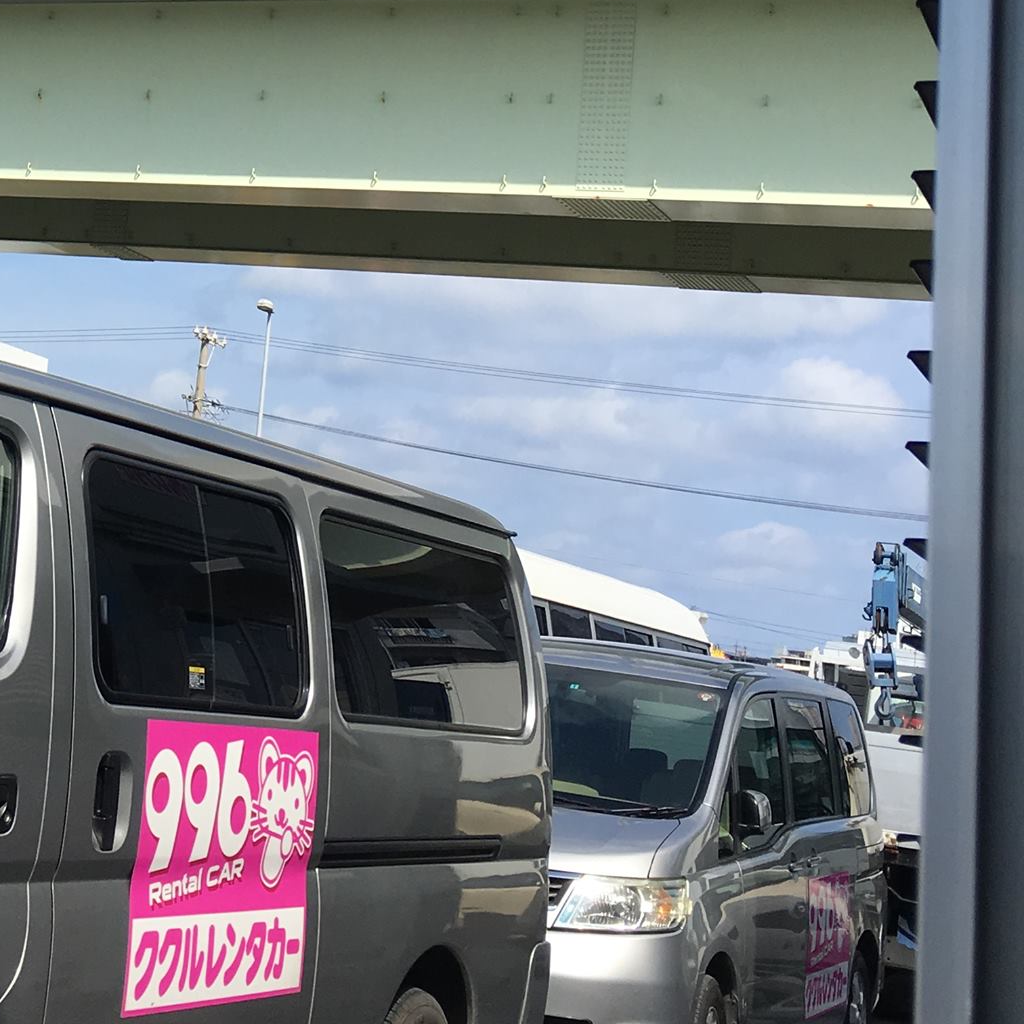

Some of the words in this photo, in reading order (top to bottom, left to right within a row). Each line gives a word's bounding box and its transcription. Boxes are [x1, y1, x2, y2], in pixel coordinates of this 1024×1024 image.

[145, 739, 252, 874] 996
[148, 867, 204, 907] Rental
[206, 858, 245, 890] CAR
[134, 916, 301, 1002] ククルレンタカー
